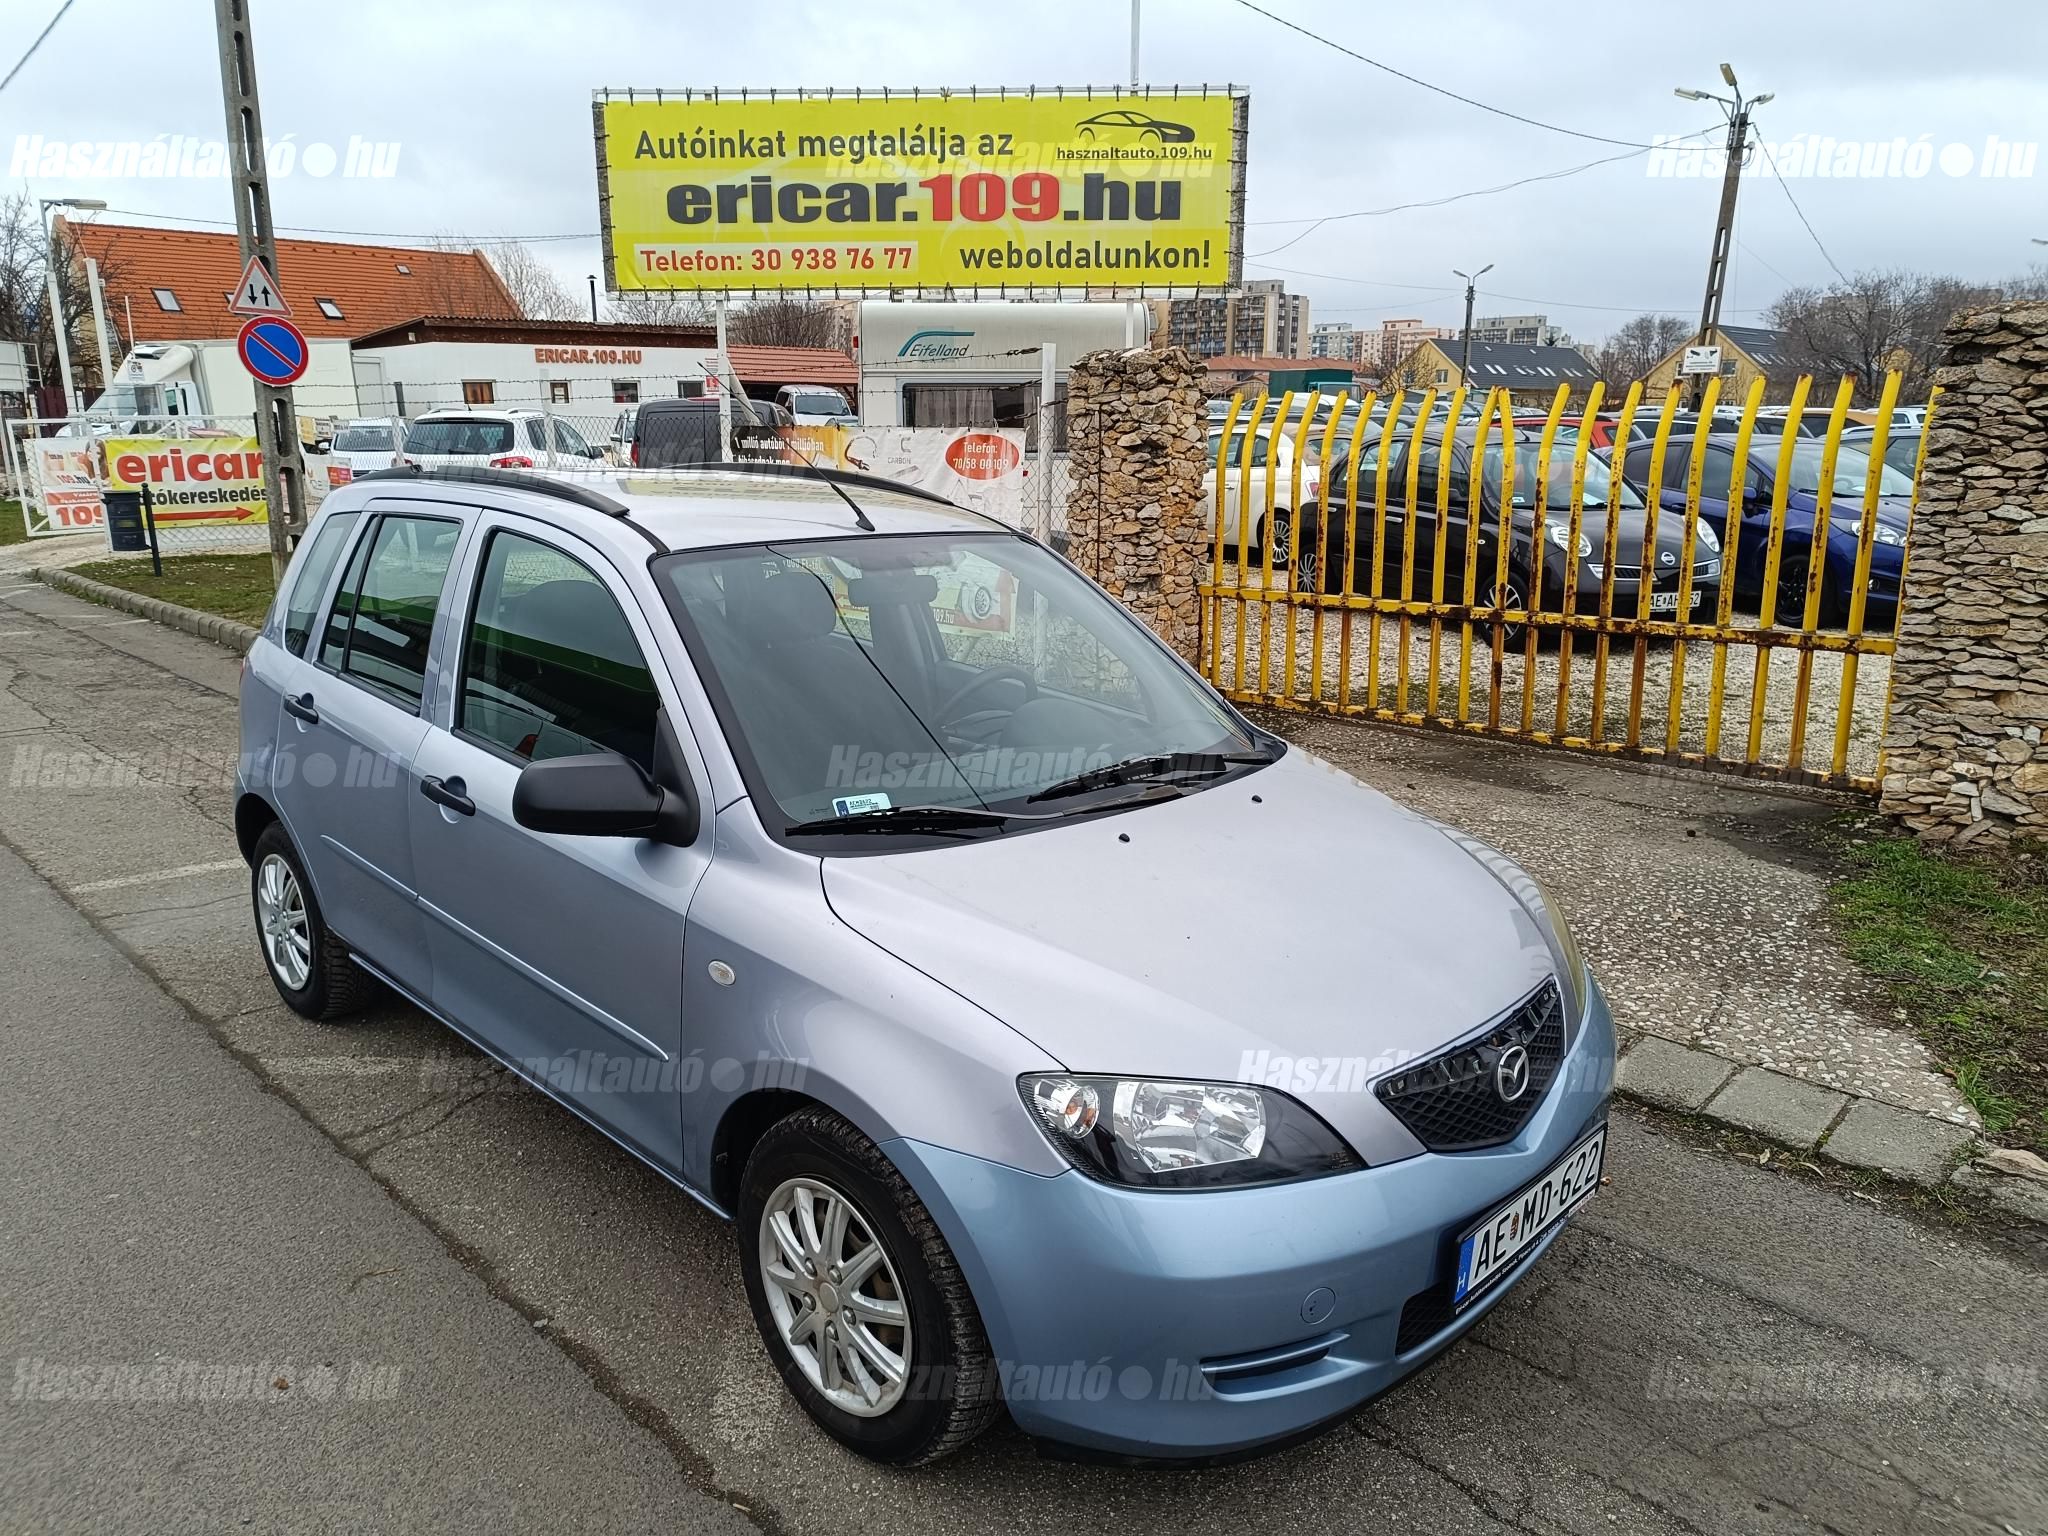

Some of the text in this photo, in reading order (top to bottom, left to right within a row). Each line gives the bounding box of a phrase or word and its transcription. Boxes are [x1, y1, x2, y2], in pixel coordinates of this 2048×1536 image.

[634, 123, 1014, 164] Autóinkat megtalálja az
[1056, 146, 1213, 161] hasznaltauto.109.hu
[666, 172, 1181, 224] ericar.109.hu
[640, 247, 912, 272] Telefon: 30 938 76 77
[959, 239, 1211, 271] weboldalunkon!
[534, 348, 642, 365] ERICAR.109.HU
[909, 343, 969, 358] Eifelland
[963, 442, 998, 454] Telefon:
[116, 448, 264, 484] ericar
[953, 458, 977, 470] 70/58
[1474, 1140, 1600, 1280] AE MD-622
